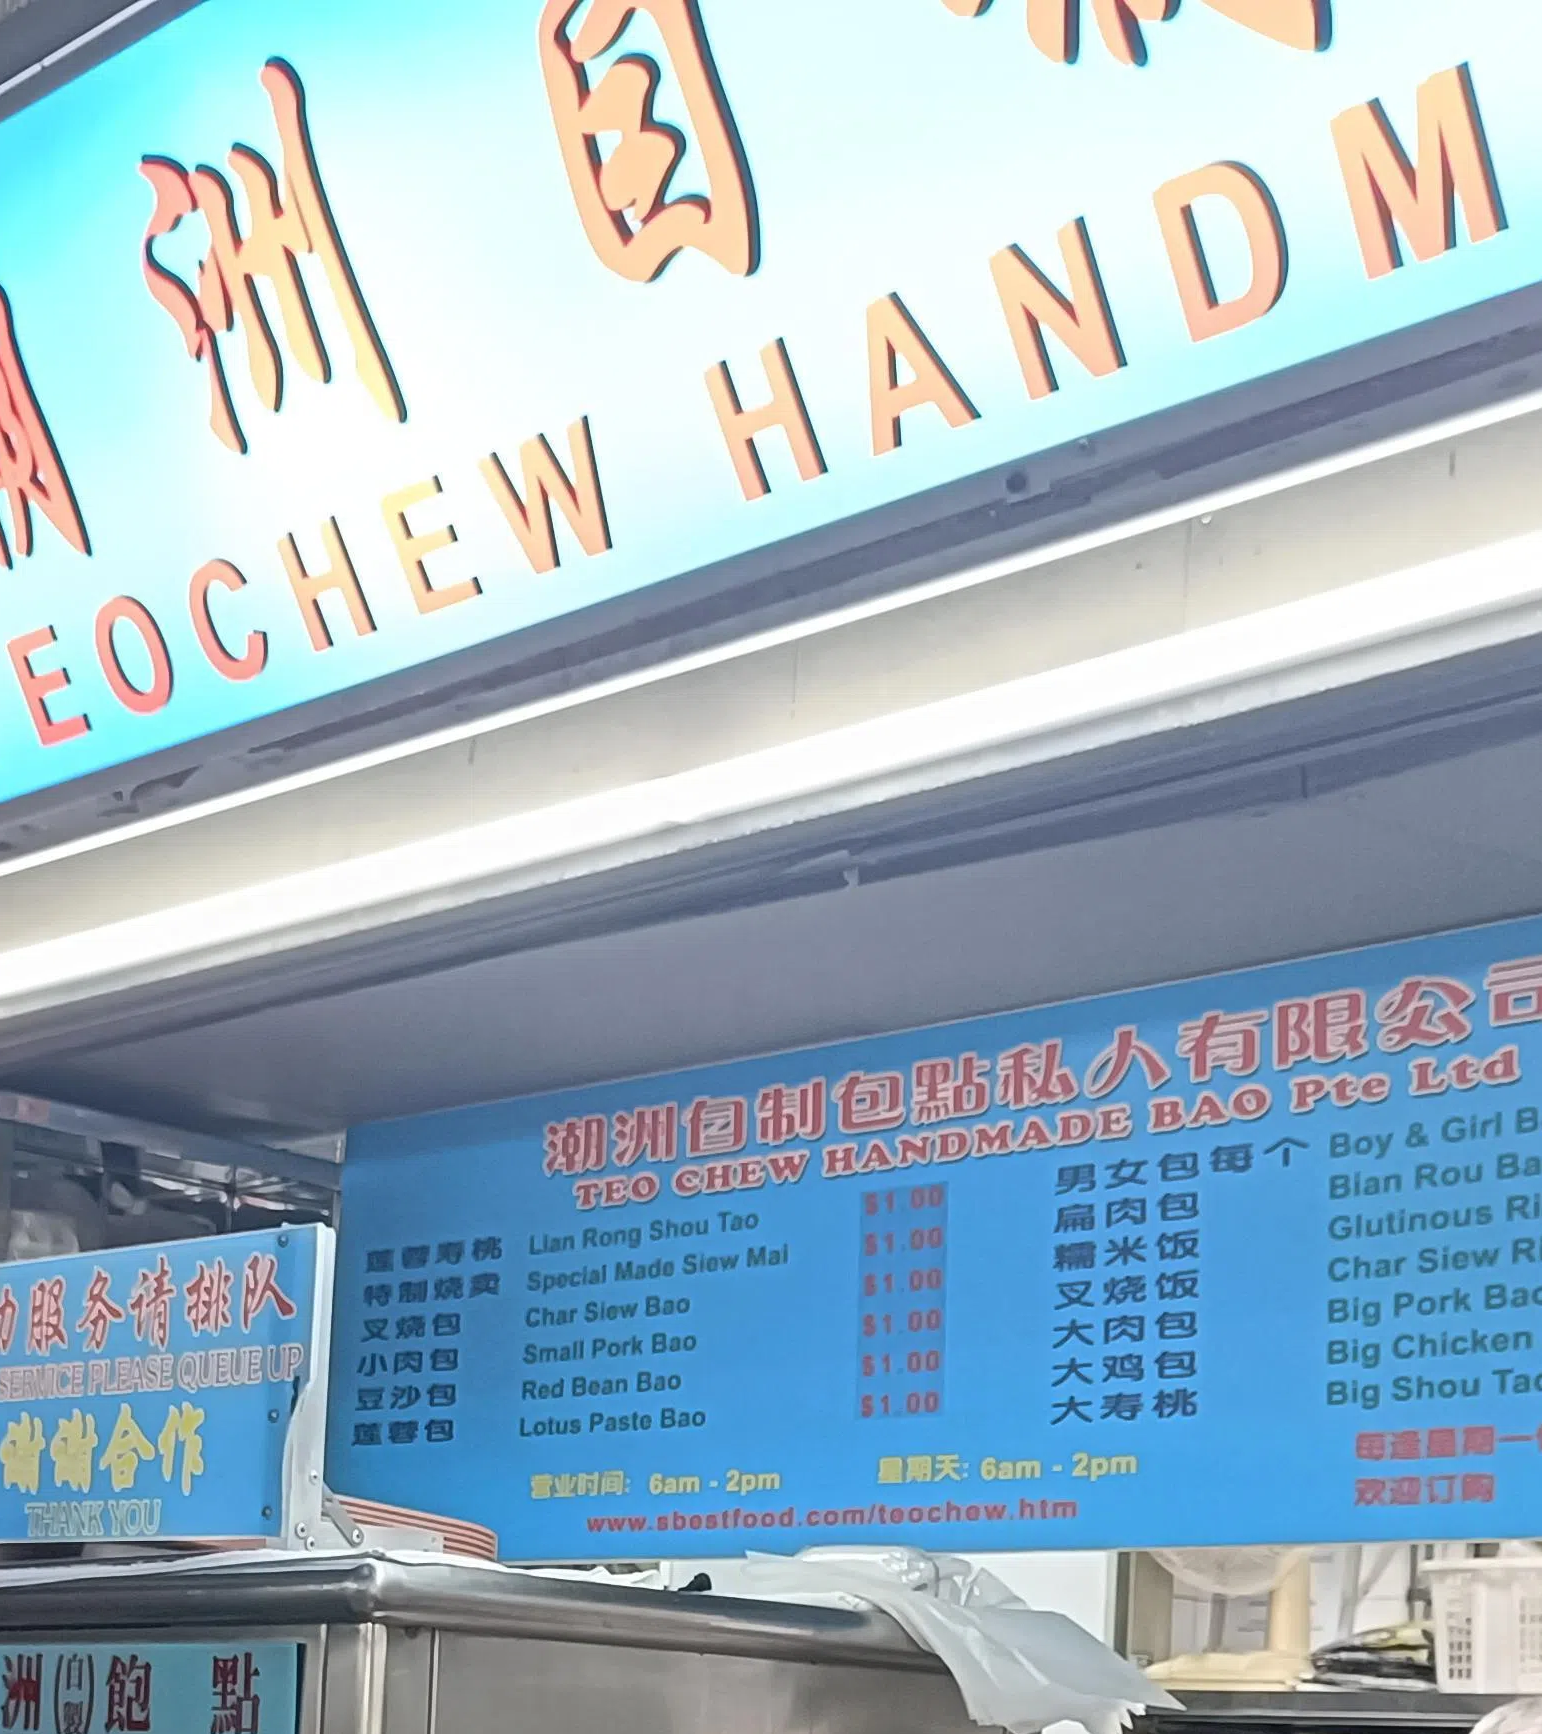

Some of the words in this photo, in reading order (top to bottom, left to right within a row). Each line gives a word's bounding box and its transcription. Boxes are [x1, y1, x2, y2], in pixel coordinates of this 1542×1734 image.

[573, 1171, 660, 1209] TEO
[671, 1150, 810, 1196] CHEW
[822, 1103, 1132, 1177] HANDMADE
[1148, 1084, 1271, 1134] BAO
[1290, 1073, 1389, 1113] Pte
[1409, 1044, 1519, 1096] Ltd
[1329, 1131, 1394, 1160] Boy
[1405, 1121, 1429, 1148] &
[1441, 1111, 1502, 1143] Girl
[1328, 1172, 1402, 1200] Bian
[1414, 1162, 1483, 1190] Rou
[1053, 1192, 1199, 1234] 扁肉包
[1328, 1204, 1493, 1240] Glutinous
[529, 1234, 575, 1255] Lian
[582, 1226, 642, 1249] Rong
[649, 1218, 709, 1241] Shou
[717, 1211, 759, 1233] Tao
[1053, 1229, 1199, 1272] 糯米饭
[527, 1264, 607, 1293] Special
[614, 1258, 675, 1282] Made
[682, 1253, 739, 1275] Siew
[746, 1243, 789, 1267] Mai
[1328, 1255, 1407, 1283] Char
[1417, 1246, 1501, 1274] Siew
[1054, 1269, 1199, 1310] 叉烧饭
[1327, 1296, 1381, 1327] Big
[1393, 1288, 1472, 1318] Pork
[361, 1313, 461, 1342] 叉烧包
[525, 1304, 577, 1328] Char
[584, 1300, 638, 1323] Siew
[645, 1295, 690, 1317] Bao
[1052, 1311, 1198, 1349] 大肉包
[357, 1348, 458, 1376] 小肉包
[522, 1340, 584, 1364] Small
[591, 1335, 643, 1359] Pork
[651, 1332, 697, 1354] Bao
[1327, 1338, 1381, 1369] Big
[1392, 1327, 1533, 1361] Chicken
[88, 1355, 173, 1395] PLEASE
[178, 1346, 262, 1394] QUEUE
[267, 1344, 303, 1383] UP
[521, 1379, 564, 1401] Red
[571, 1375, 628, 1397] Bean
[636, 1371, 681, 1392] Bao
[1051, 1350, 1197, 1387] 大鸡包
[355, 1383, 456, 1411] 豆沙包
[1050, 1388, 1198, 1425] 大寿桃
[1326, 1379, 1381, 1411] Big
[1392, 1374, 1480, 1402] Shou
[519, 1414, 581, 1437] Lotus
[589, 1411, 652, 1433] Paste
[660, 1407, 706, 1428] Bao
[648, 1472, 700, 1495] 6am
[725, 1468, 780, 1496] 2pm
[980, 1457, 1041, 1480] 6am
[1071, 1452, 1137, 1481] 2pm
[25, 1501, 105, 1538] THANK
[107, 1499, 163, 1538] YOU
